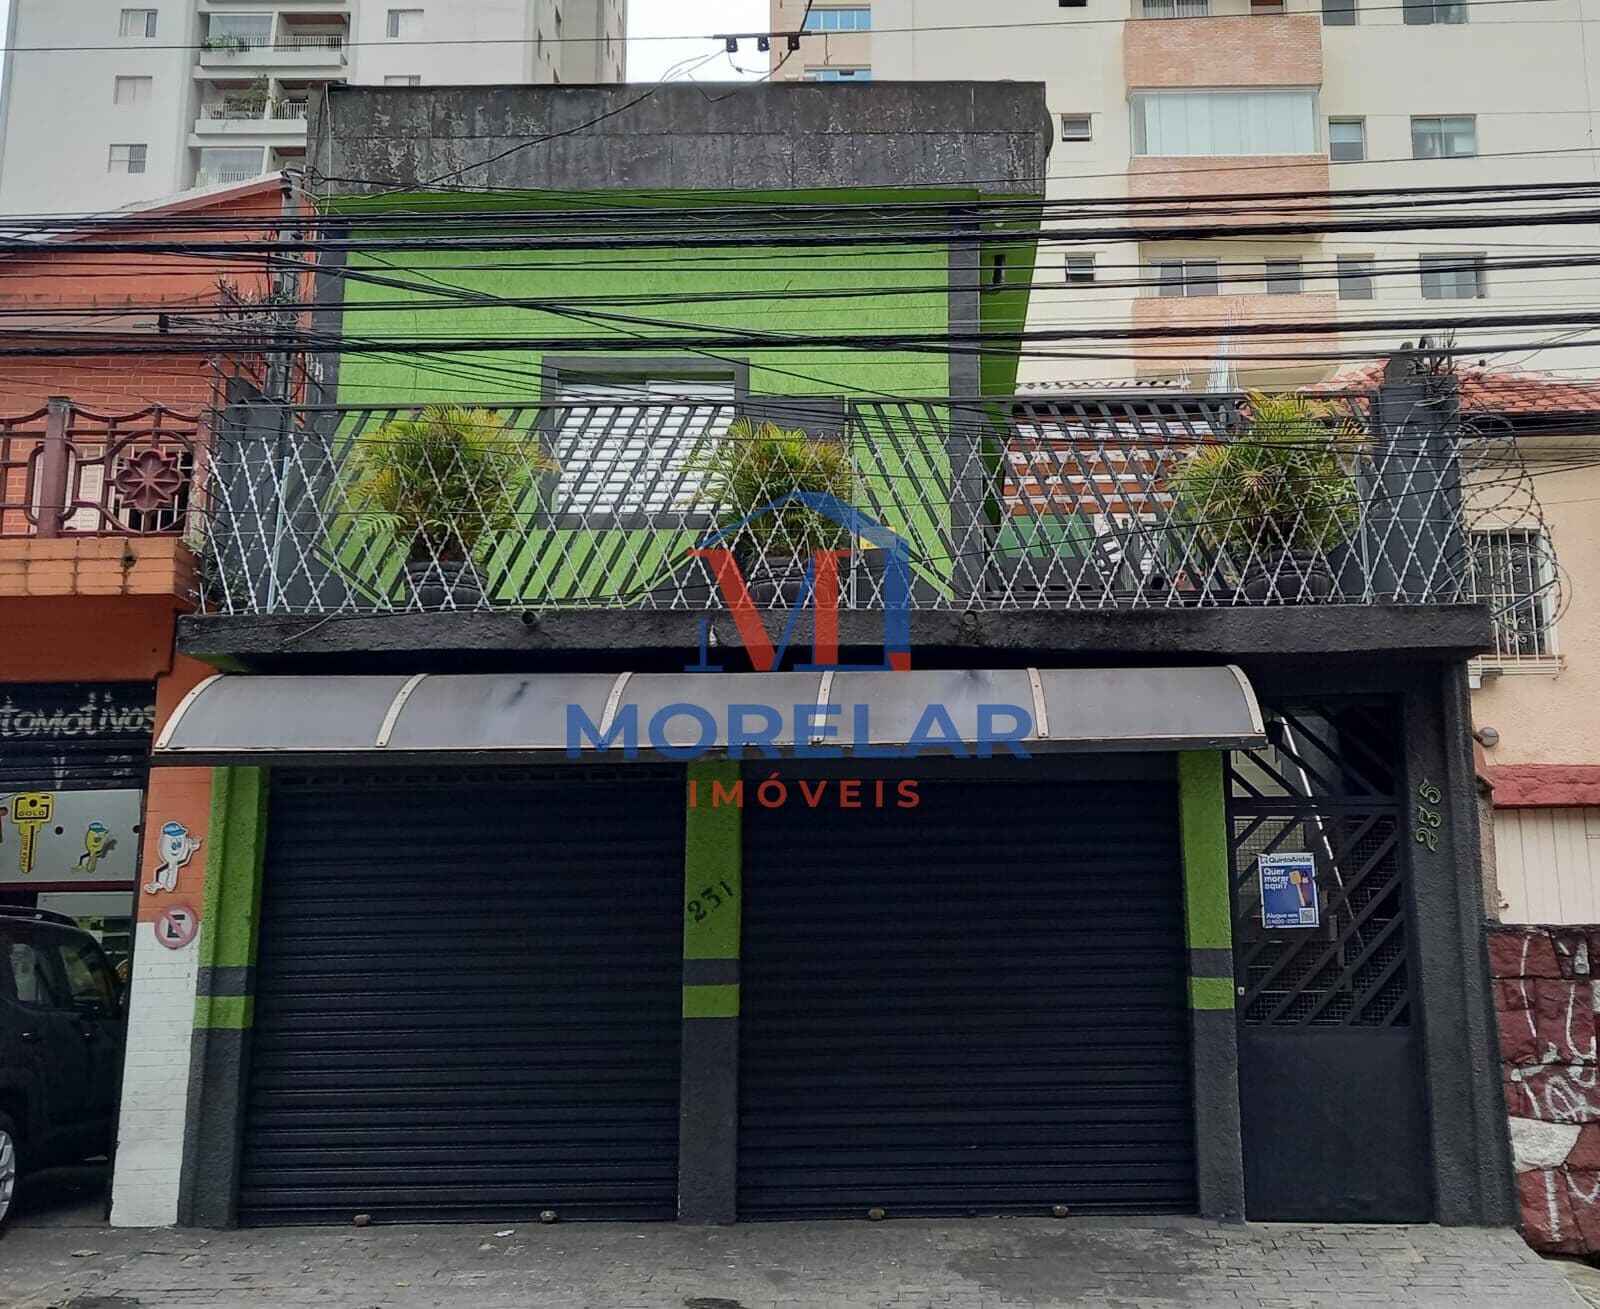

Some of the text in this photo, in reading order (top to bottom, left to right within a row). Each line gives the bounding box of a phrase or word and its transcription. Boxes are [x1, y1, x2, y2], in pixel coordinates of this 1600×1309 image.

[1416, 778, 1441, 852] 235
[1268, 855, 1312, 864] QuintoAndar
[1263, 867, 1285, 876] Quer
[1264, 882, 1288, 892] aqui?
[687, 881, 734, 923] 231
